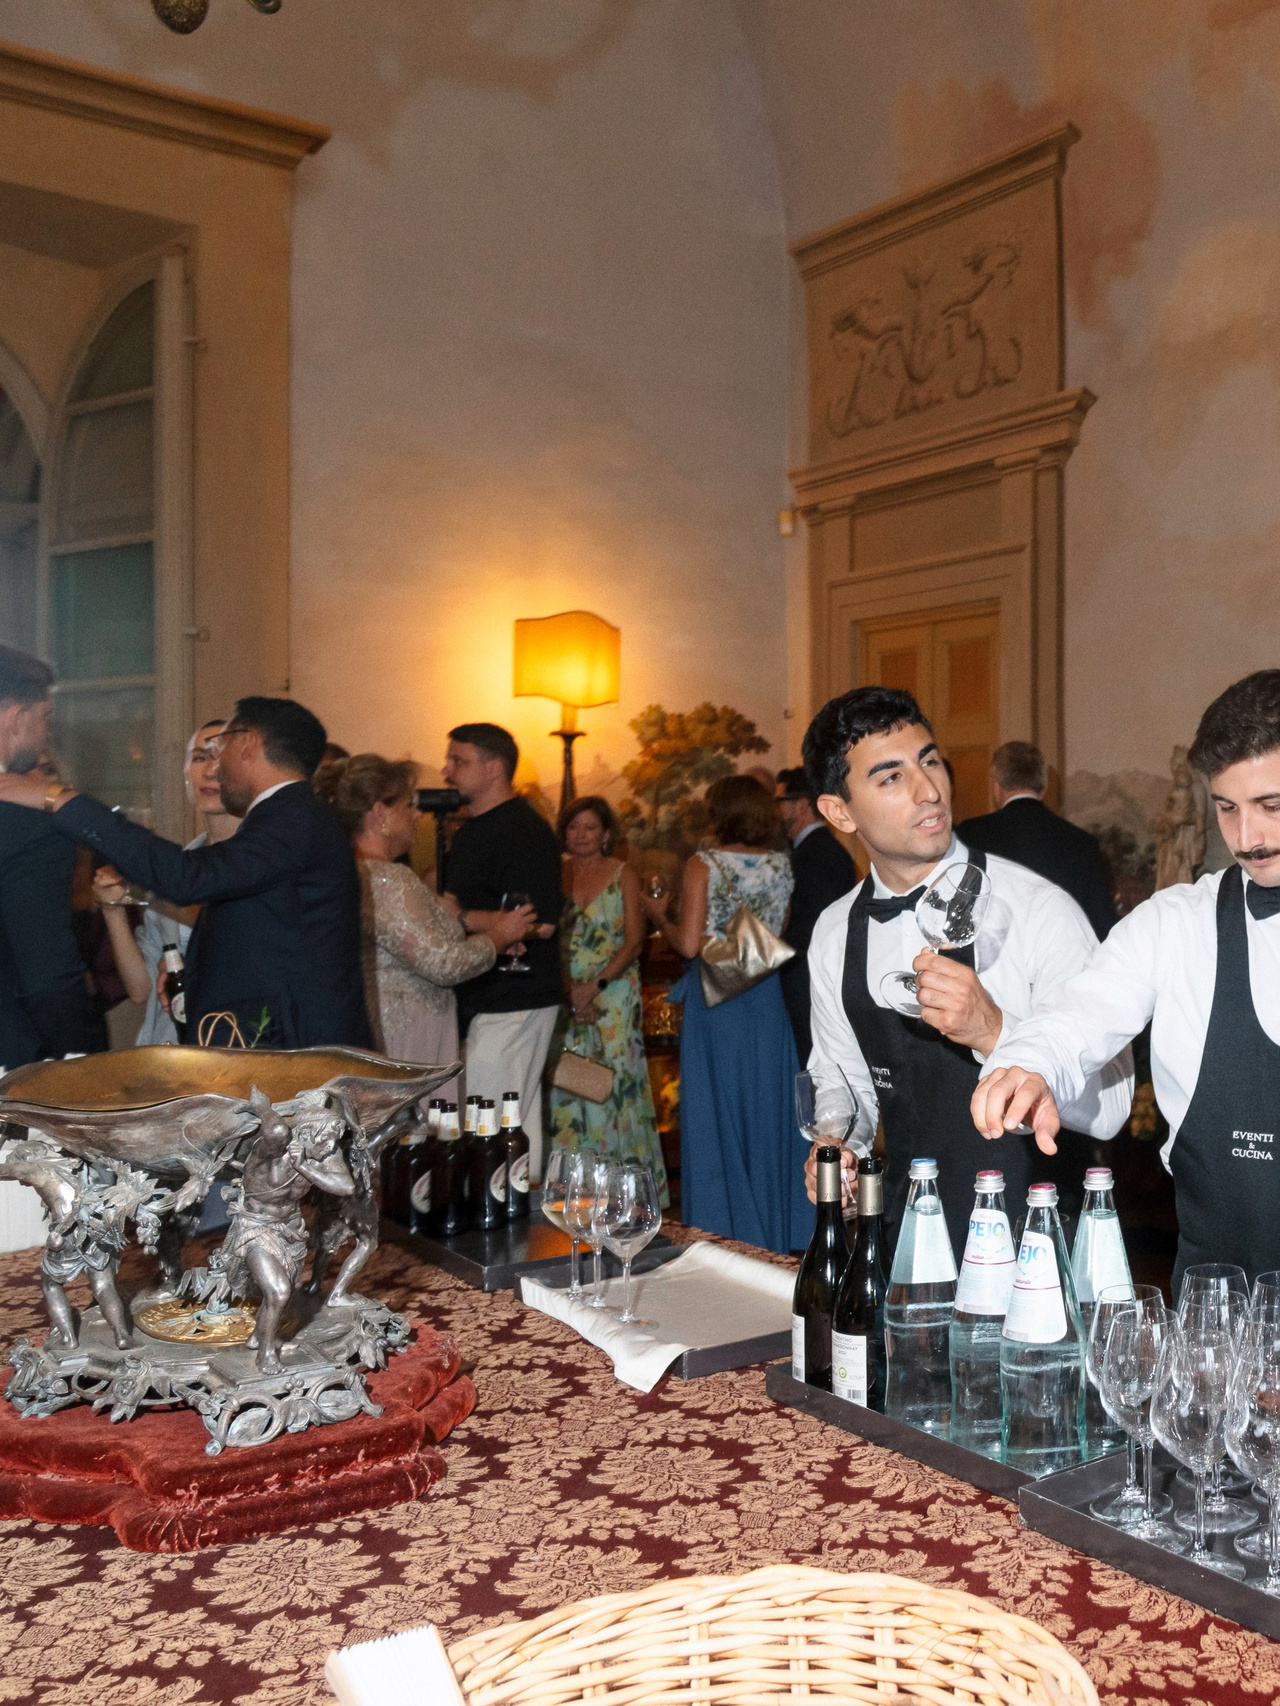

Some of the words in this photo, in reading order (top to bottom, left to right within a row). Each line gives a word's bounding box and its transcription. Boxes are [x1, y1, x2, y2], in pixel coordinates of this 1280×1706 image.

[1232, 1130, 1274, 1143] EVENTI
[1248, 1142, 1255, 1150] &
[1231, 1148, 1274, 1161] CUCINA
[969, 1219, 1006, 1241] PEJO
[1020, 1244, 1047, 1264] EJO
